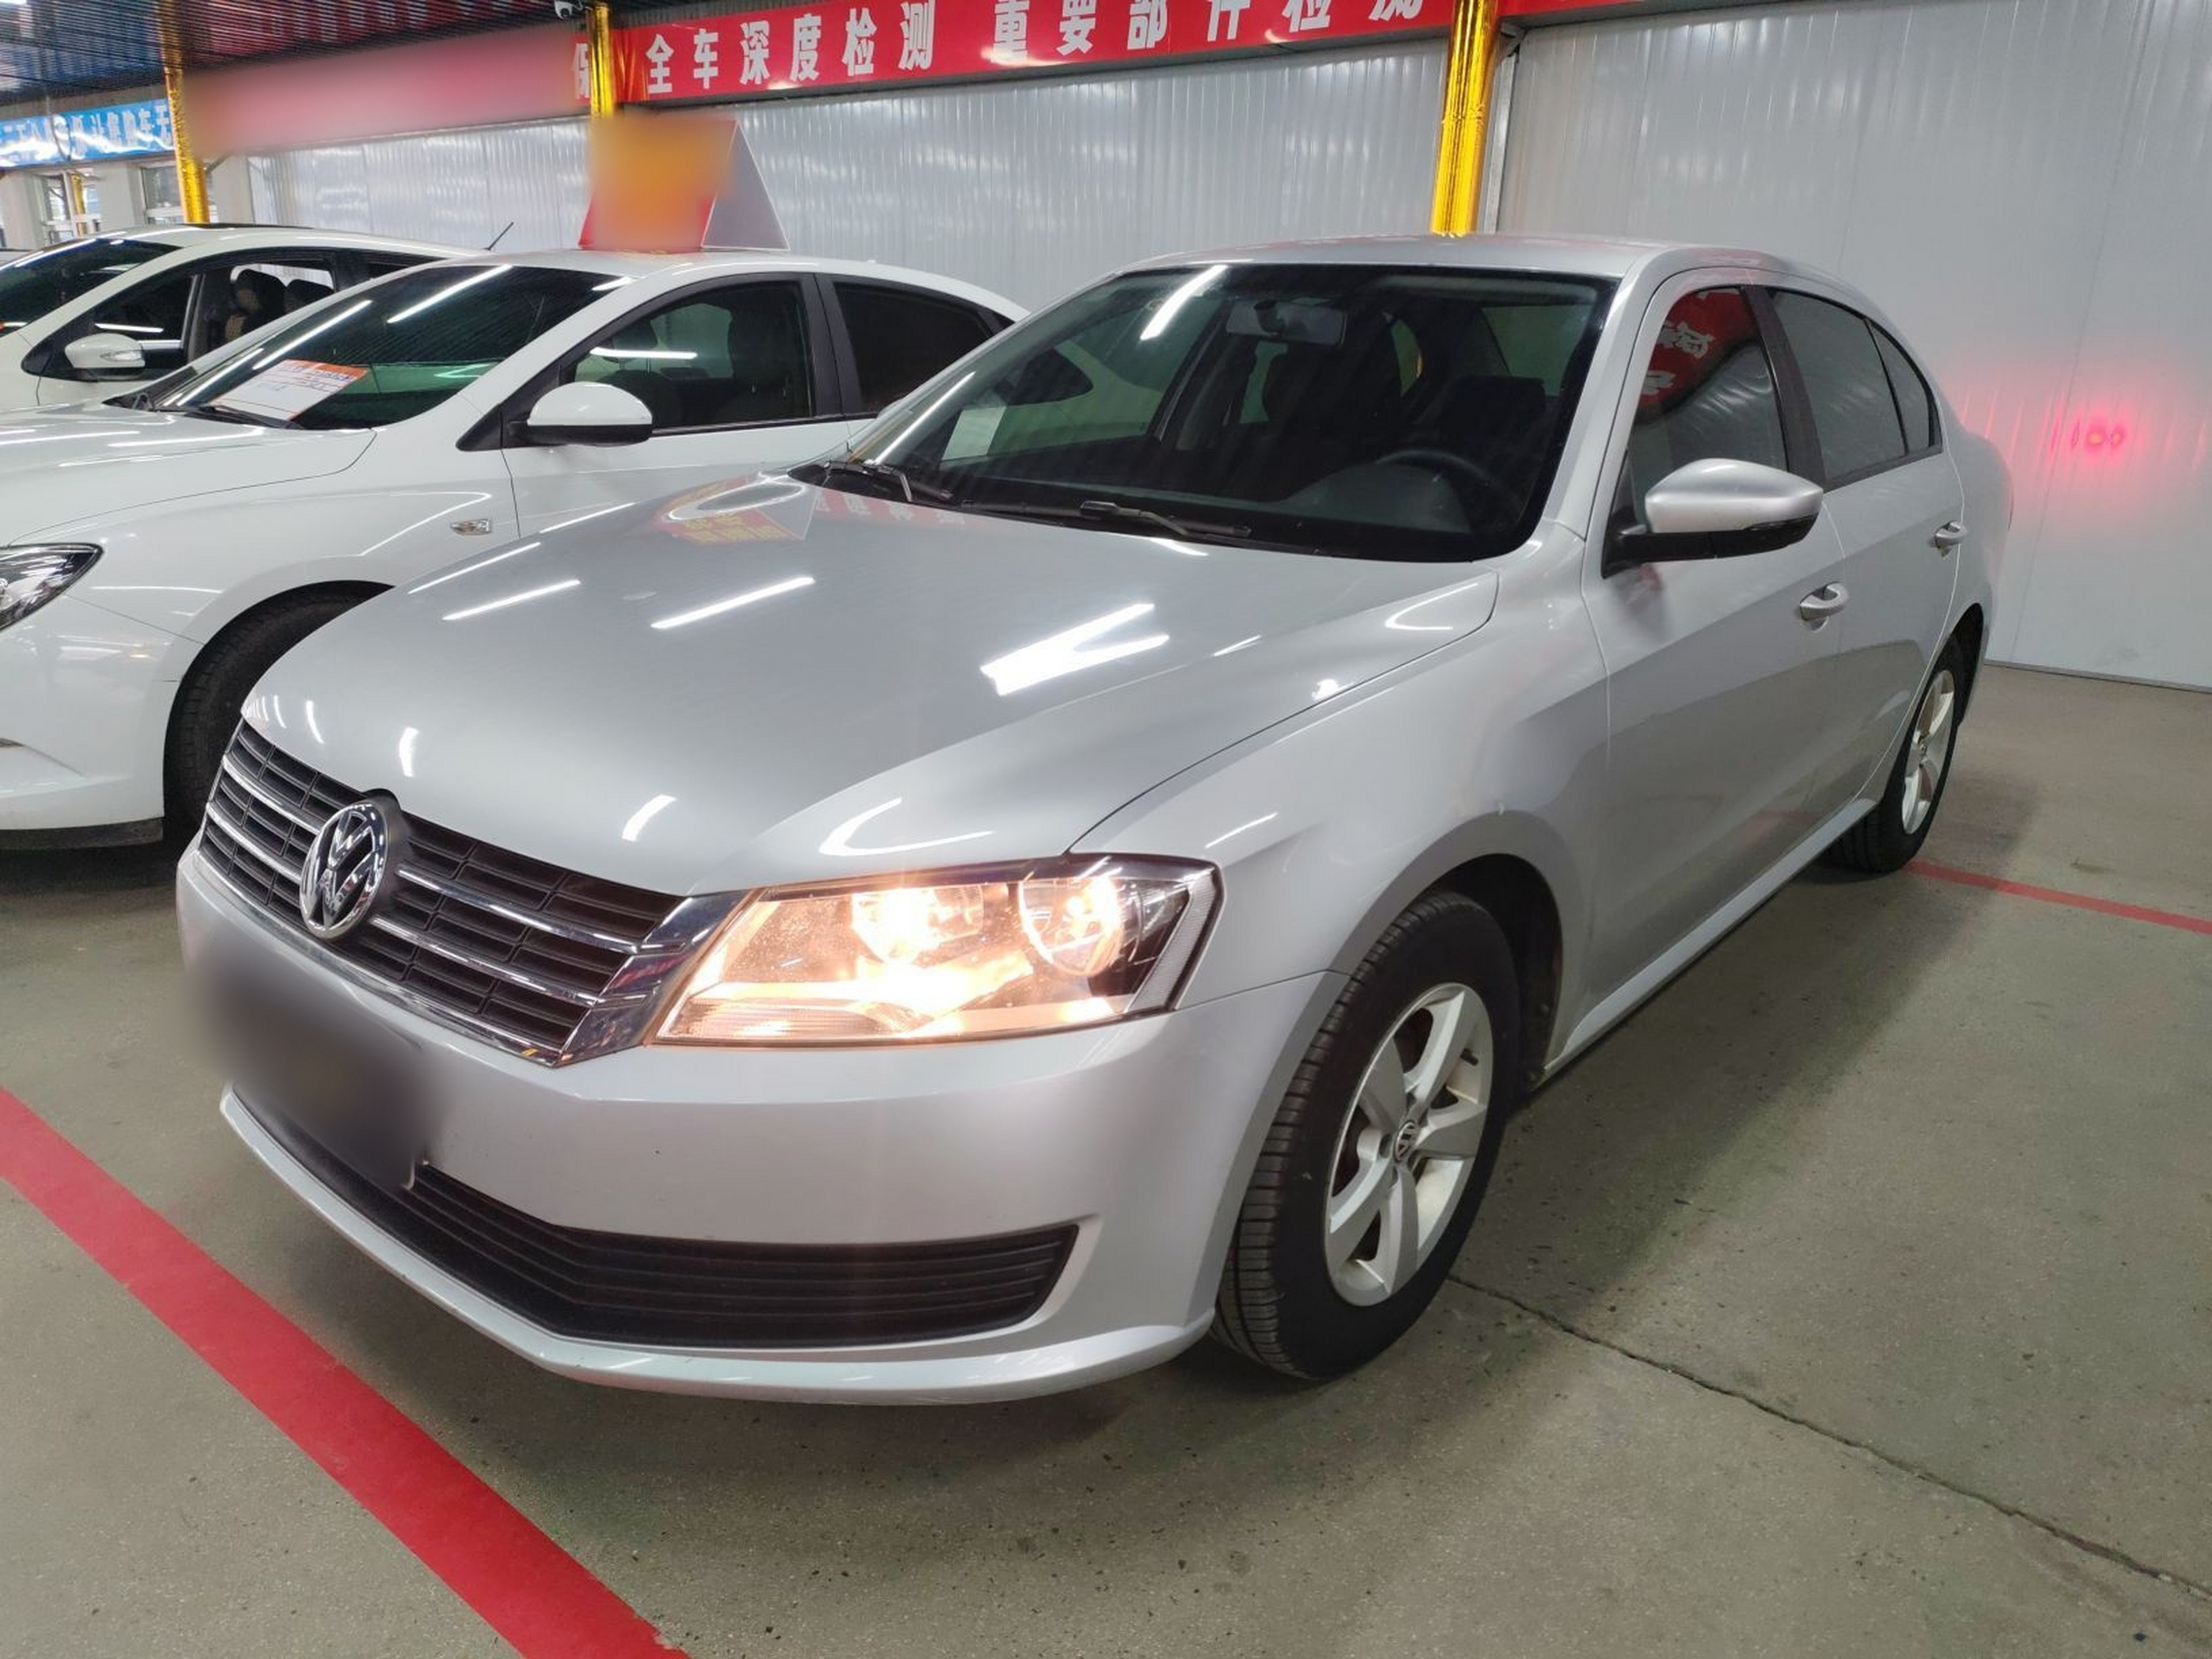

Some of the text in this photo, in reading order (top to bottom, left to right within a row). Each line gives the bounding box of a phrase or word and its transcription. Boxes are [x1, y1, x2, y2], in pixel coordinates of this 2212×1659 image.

[645, 2, 935, 94] 全车深度检测
